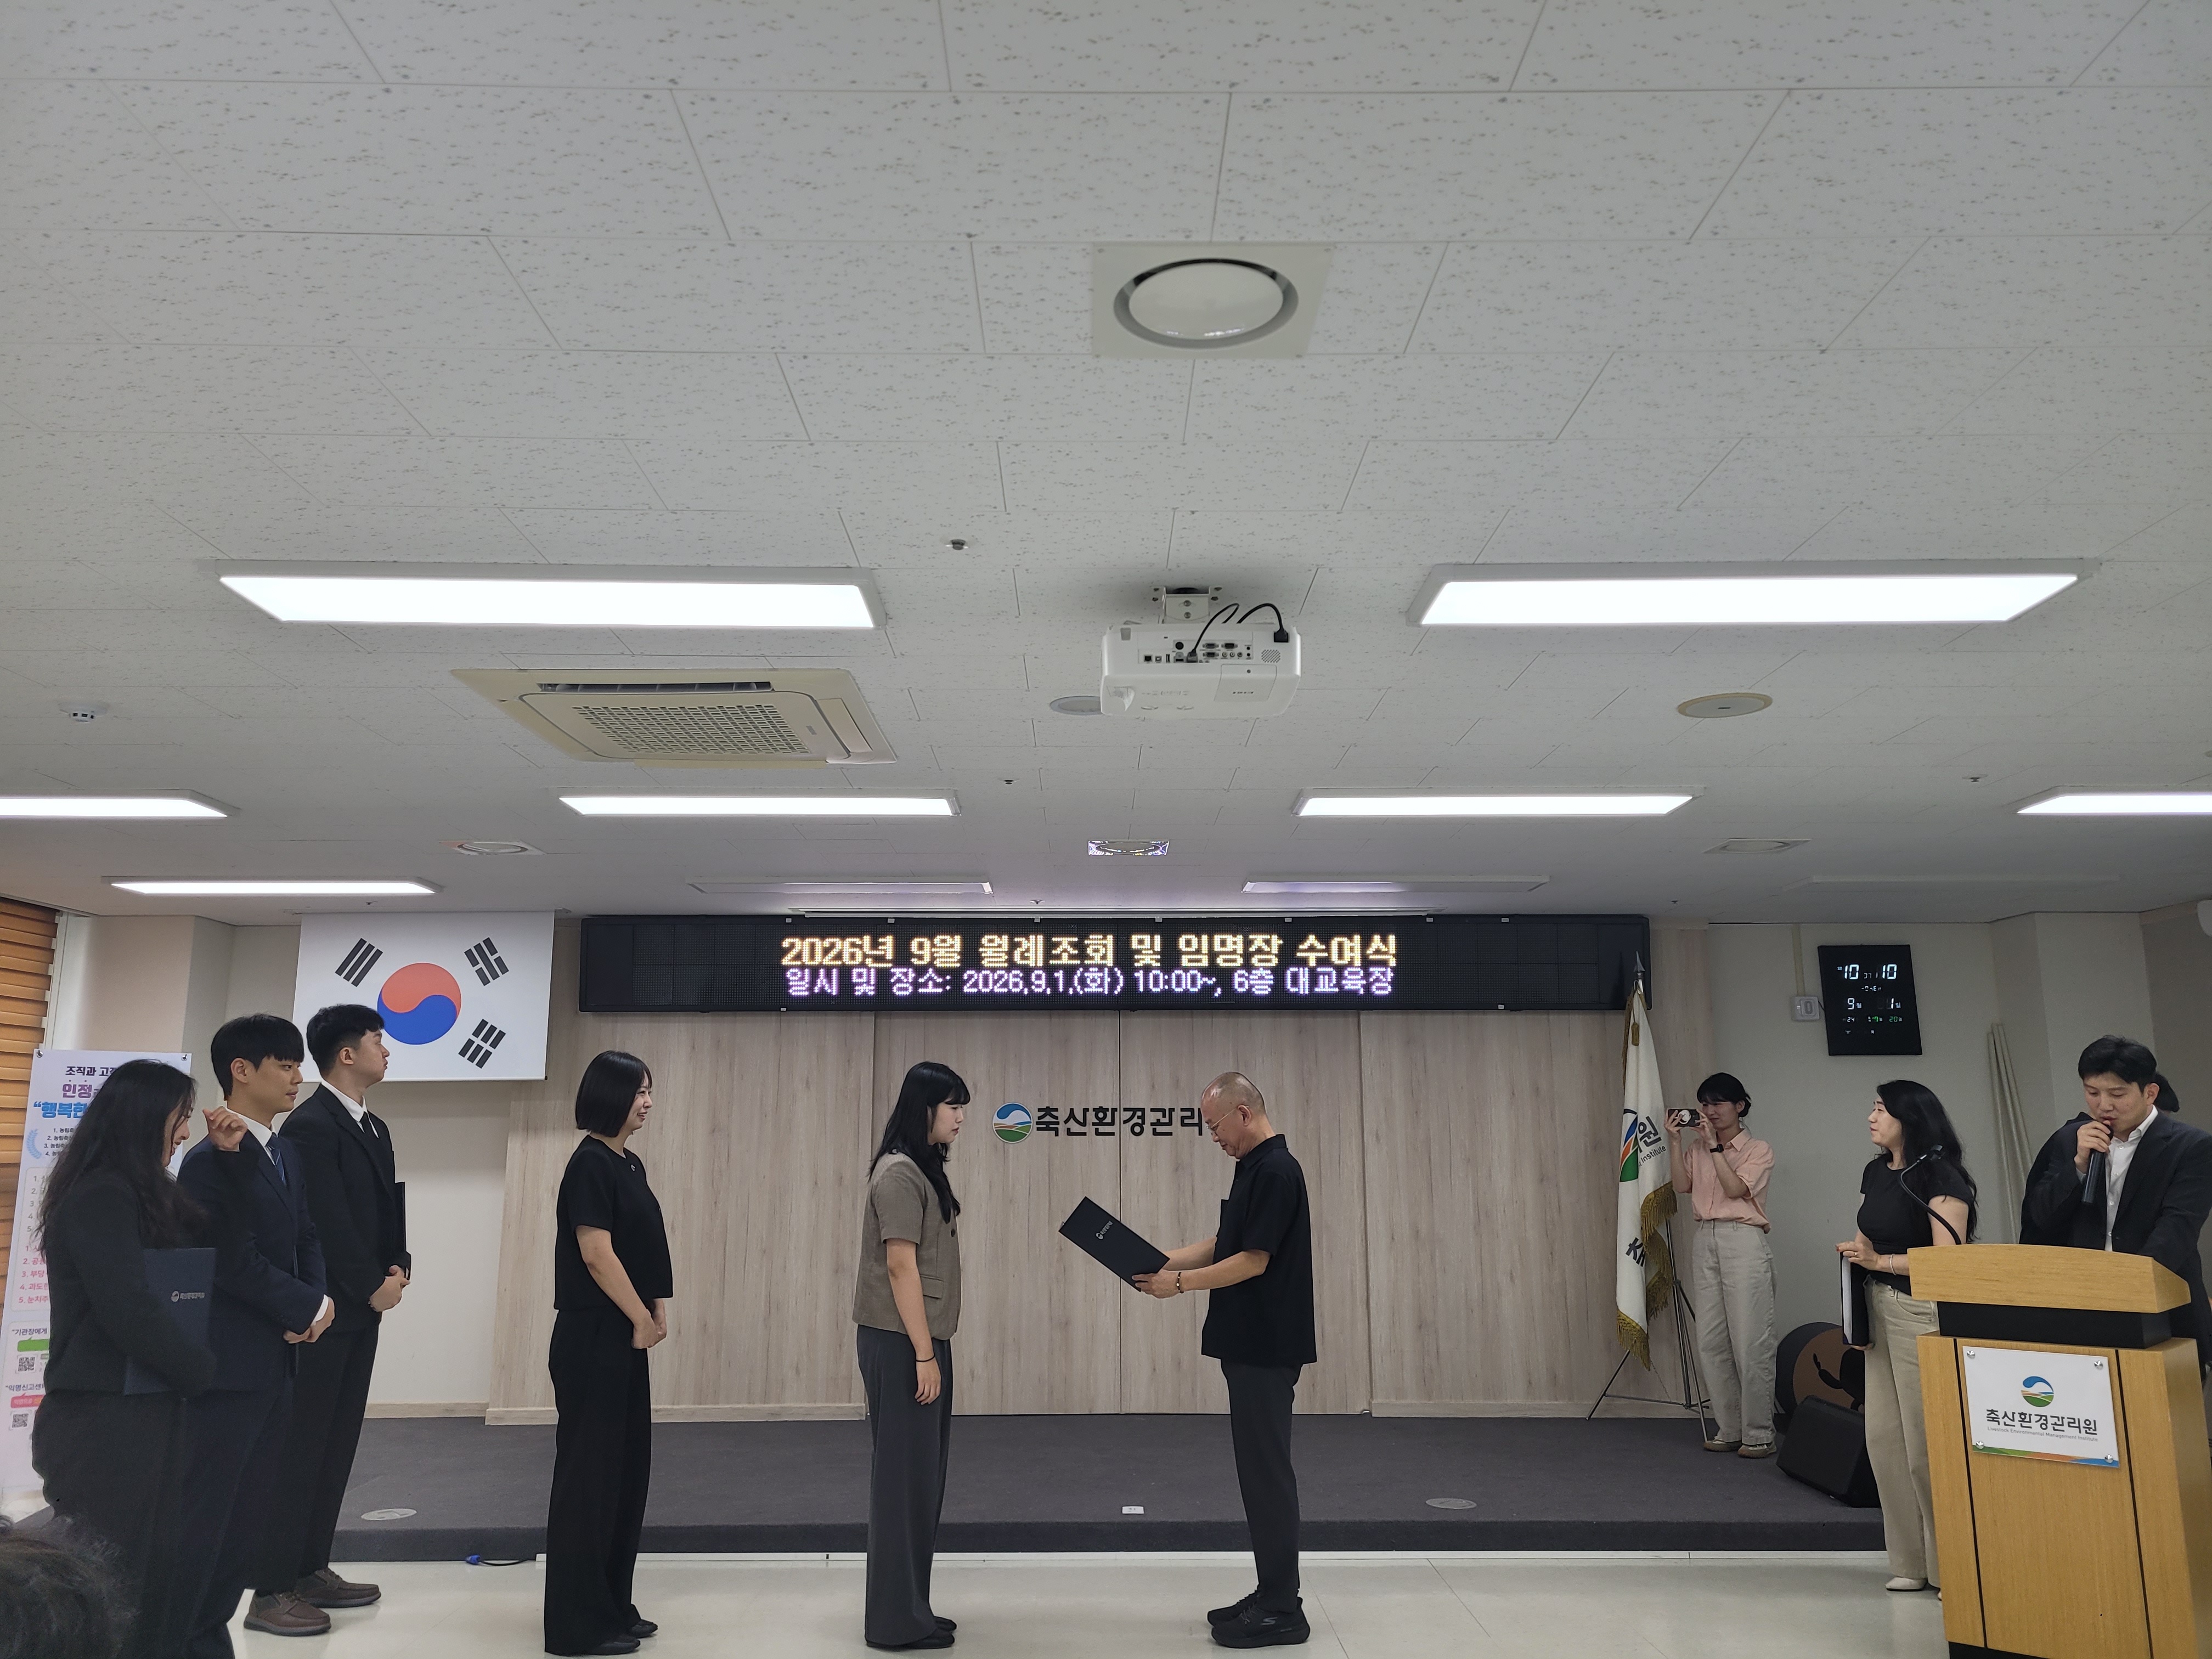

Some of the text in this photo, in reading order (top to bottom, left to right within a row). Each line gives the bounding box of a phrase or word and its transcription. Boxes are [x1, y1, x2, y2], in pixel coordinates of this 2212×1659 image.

[781, 934, 1397, 967] 2026년 9월 월례조회 및 임명장 수여식
[786, 967, 838, 996] 일시
[851, 968, 876, 996] 및
[890, 967, 951, 996] 장소:
[1233, 967, 1274, 995] 6층
[1286, 967, 1394, 996] 대교육장
[1844, 964, 1859, 980] 10
[1882, 964, 1897, 980] 10
[65, 1066, 97, 1076] 조직과
[1640, 1144, 1667, 1163] Institute
[1986, 1409, 2098, 1436] 축산환경관리원
[2010, 1428, 2044, 1436] Environmental
